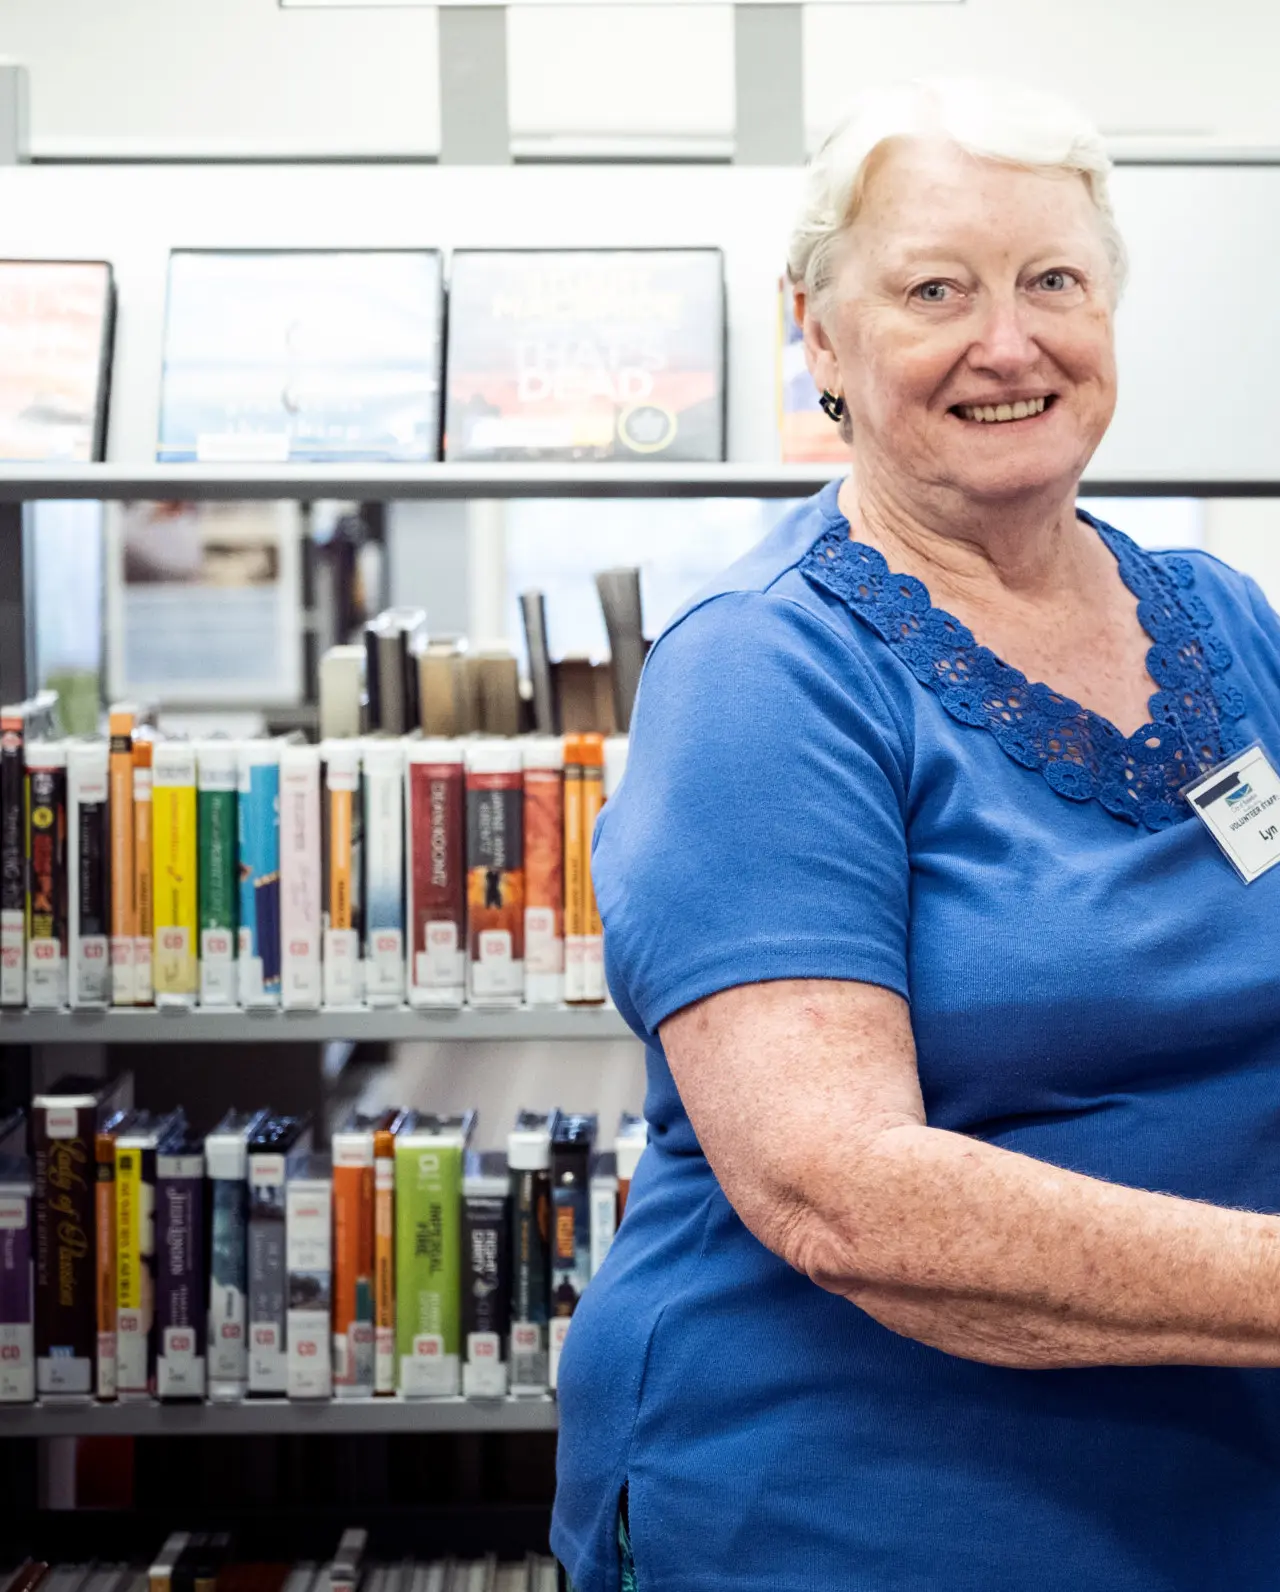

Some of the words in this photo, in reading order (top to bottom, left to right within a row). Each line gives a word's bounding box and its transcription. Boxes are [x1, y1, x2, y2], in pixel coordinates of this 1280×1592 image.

[517, 368, 653, 403] DEAD
[1229, 806, 1262, 832] VOLUNTEER
[1258, 825, 1279, 841] Lyn
[46, 1138, 90, 1192] Lady
[46, 1193, 81, 1223] of
